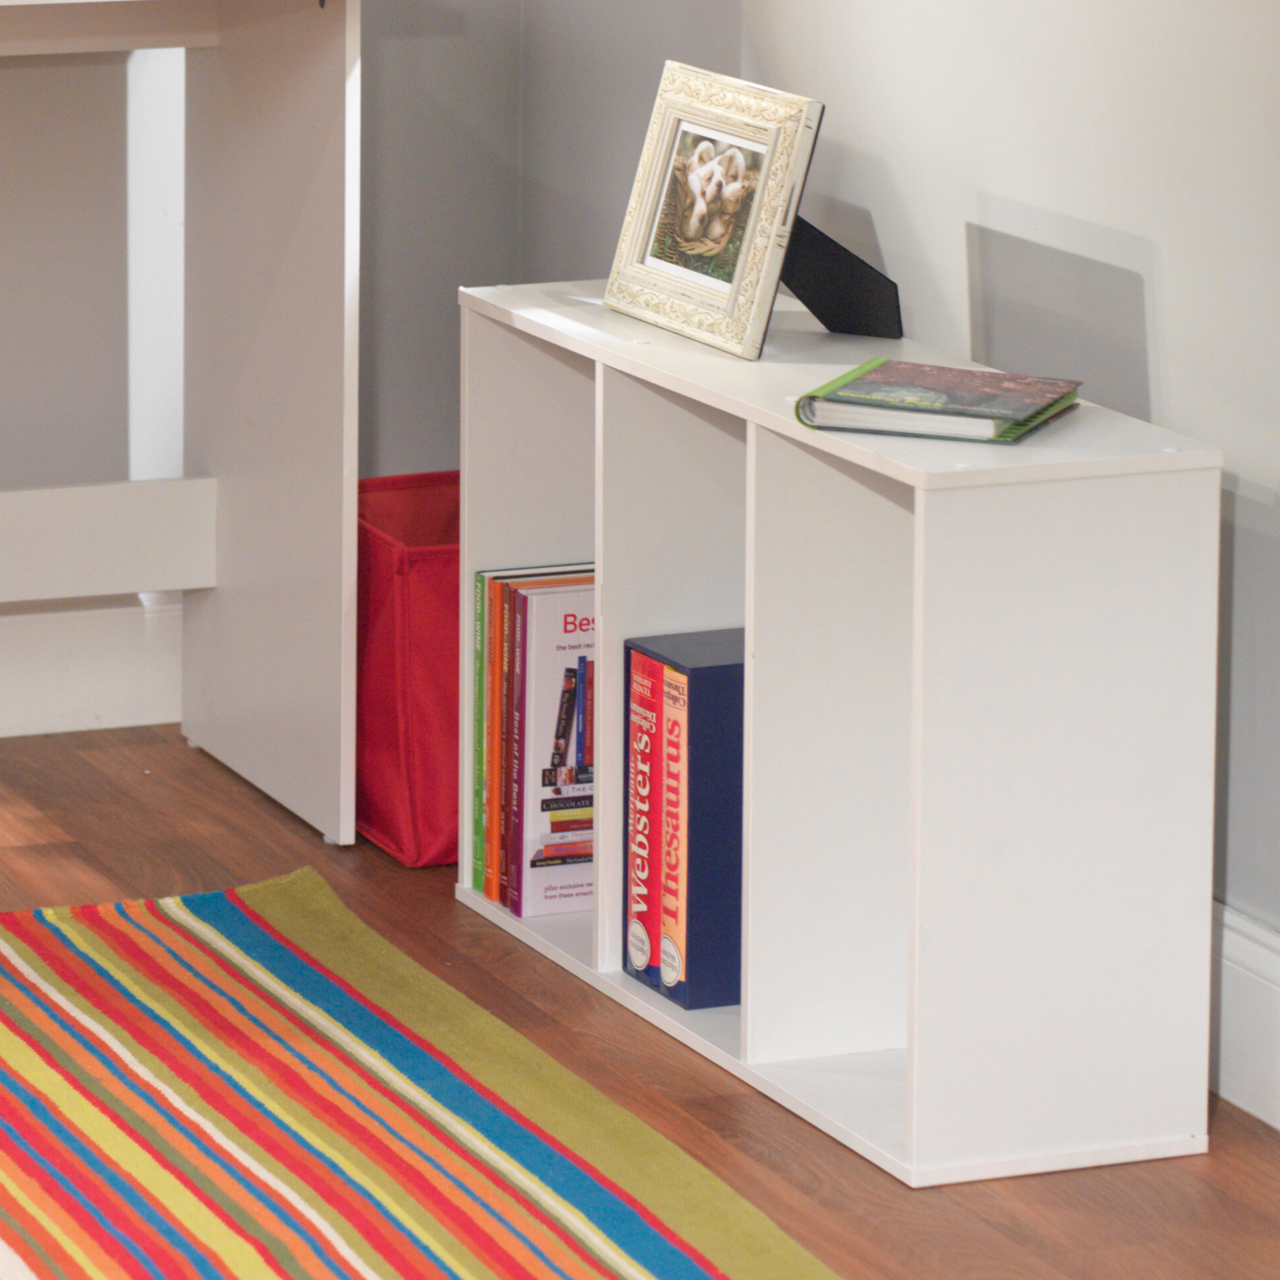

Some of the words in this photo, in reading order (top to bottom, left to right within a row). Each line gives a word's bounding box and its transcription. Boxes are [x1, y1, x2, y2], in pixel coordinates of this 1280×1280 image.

[513, 742, 519, 758] of
[631, 732, 651, 915] Webster's
[662, 718, 681, 926] Thesaurus
